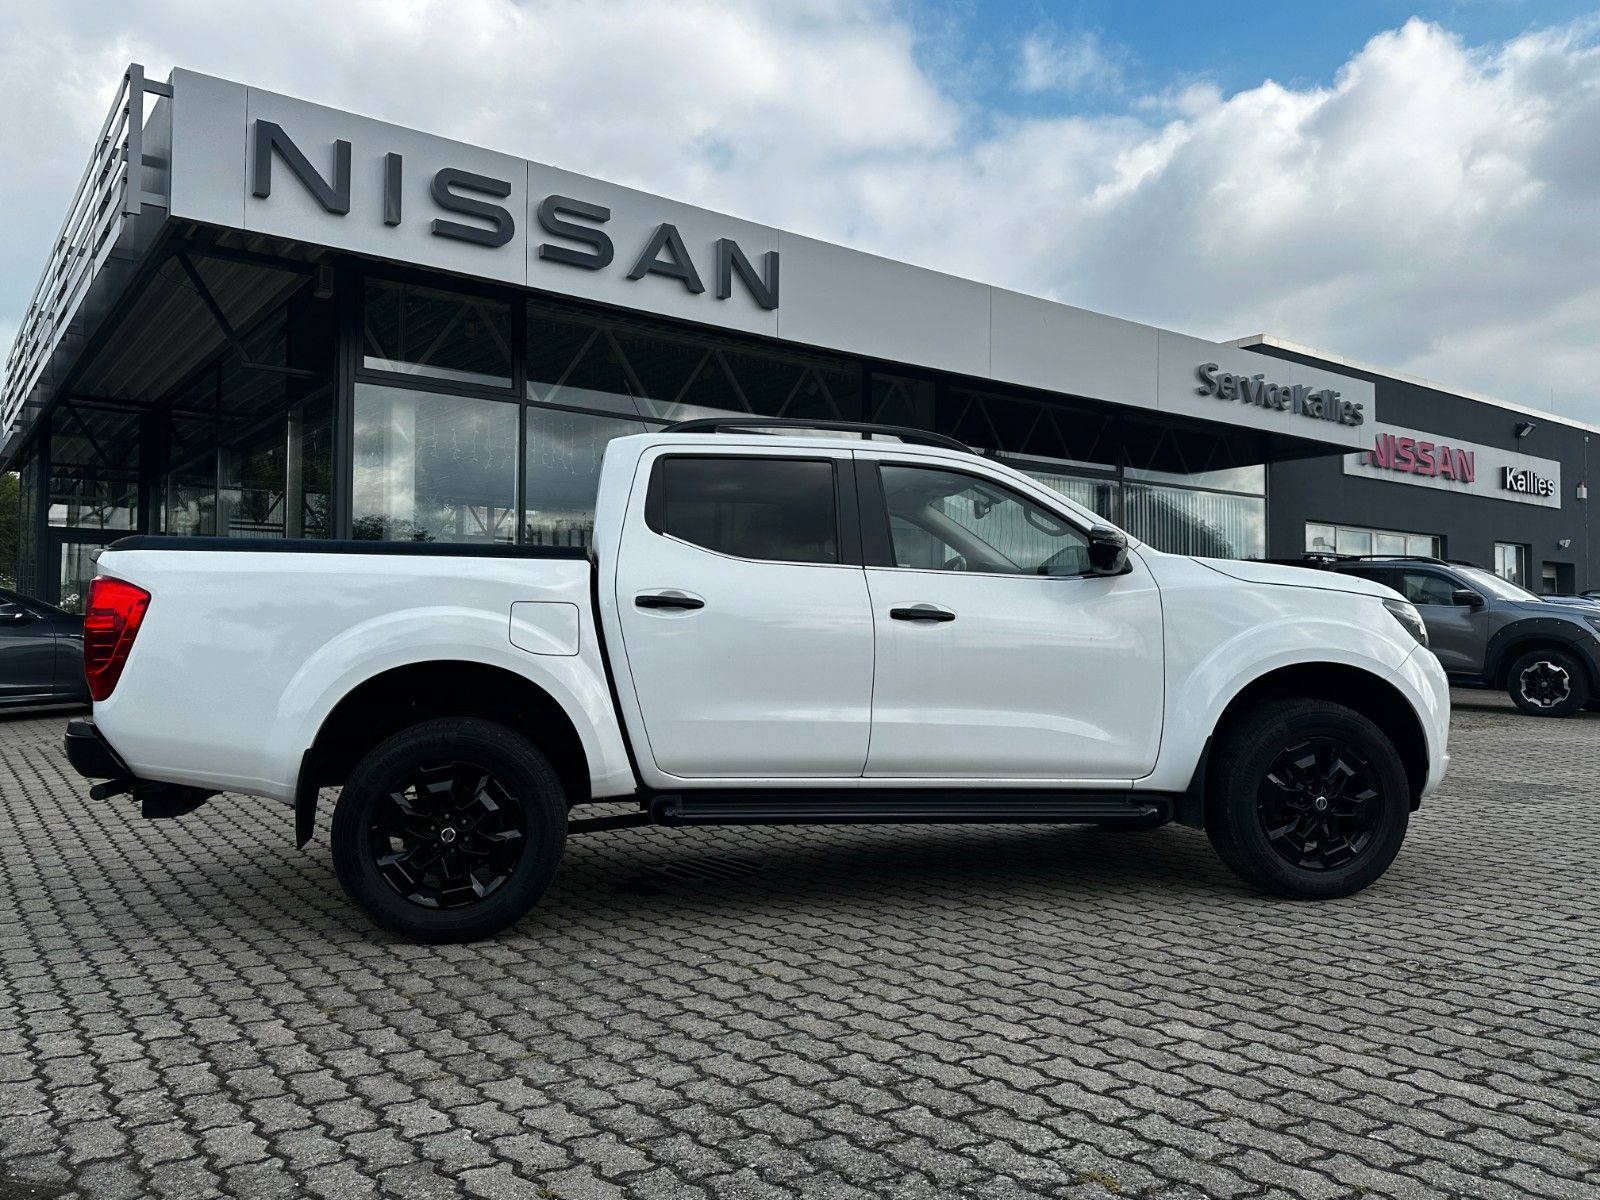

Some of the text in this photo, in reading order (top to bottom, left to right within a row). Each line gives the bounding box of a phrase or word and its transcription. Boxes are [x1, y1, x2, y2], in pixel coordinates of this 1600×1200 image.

[251, 118, 780, 311] NISSAN
[1361, 432, 1556, 497] NISSAN Kallies
